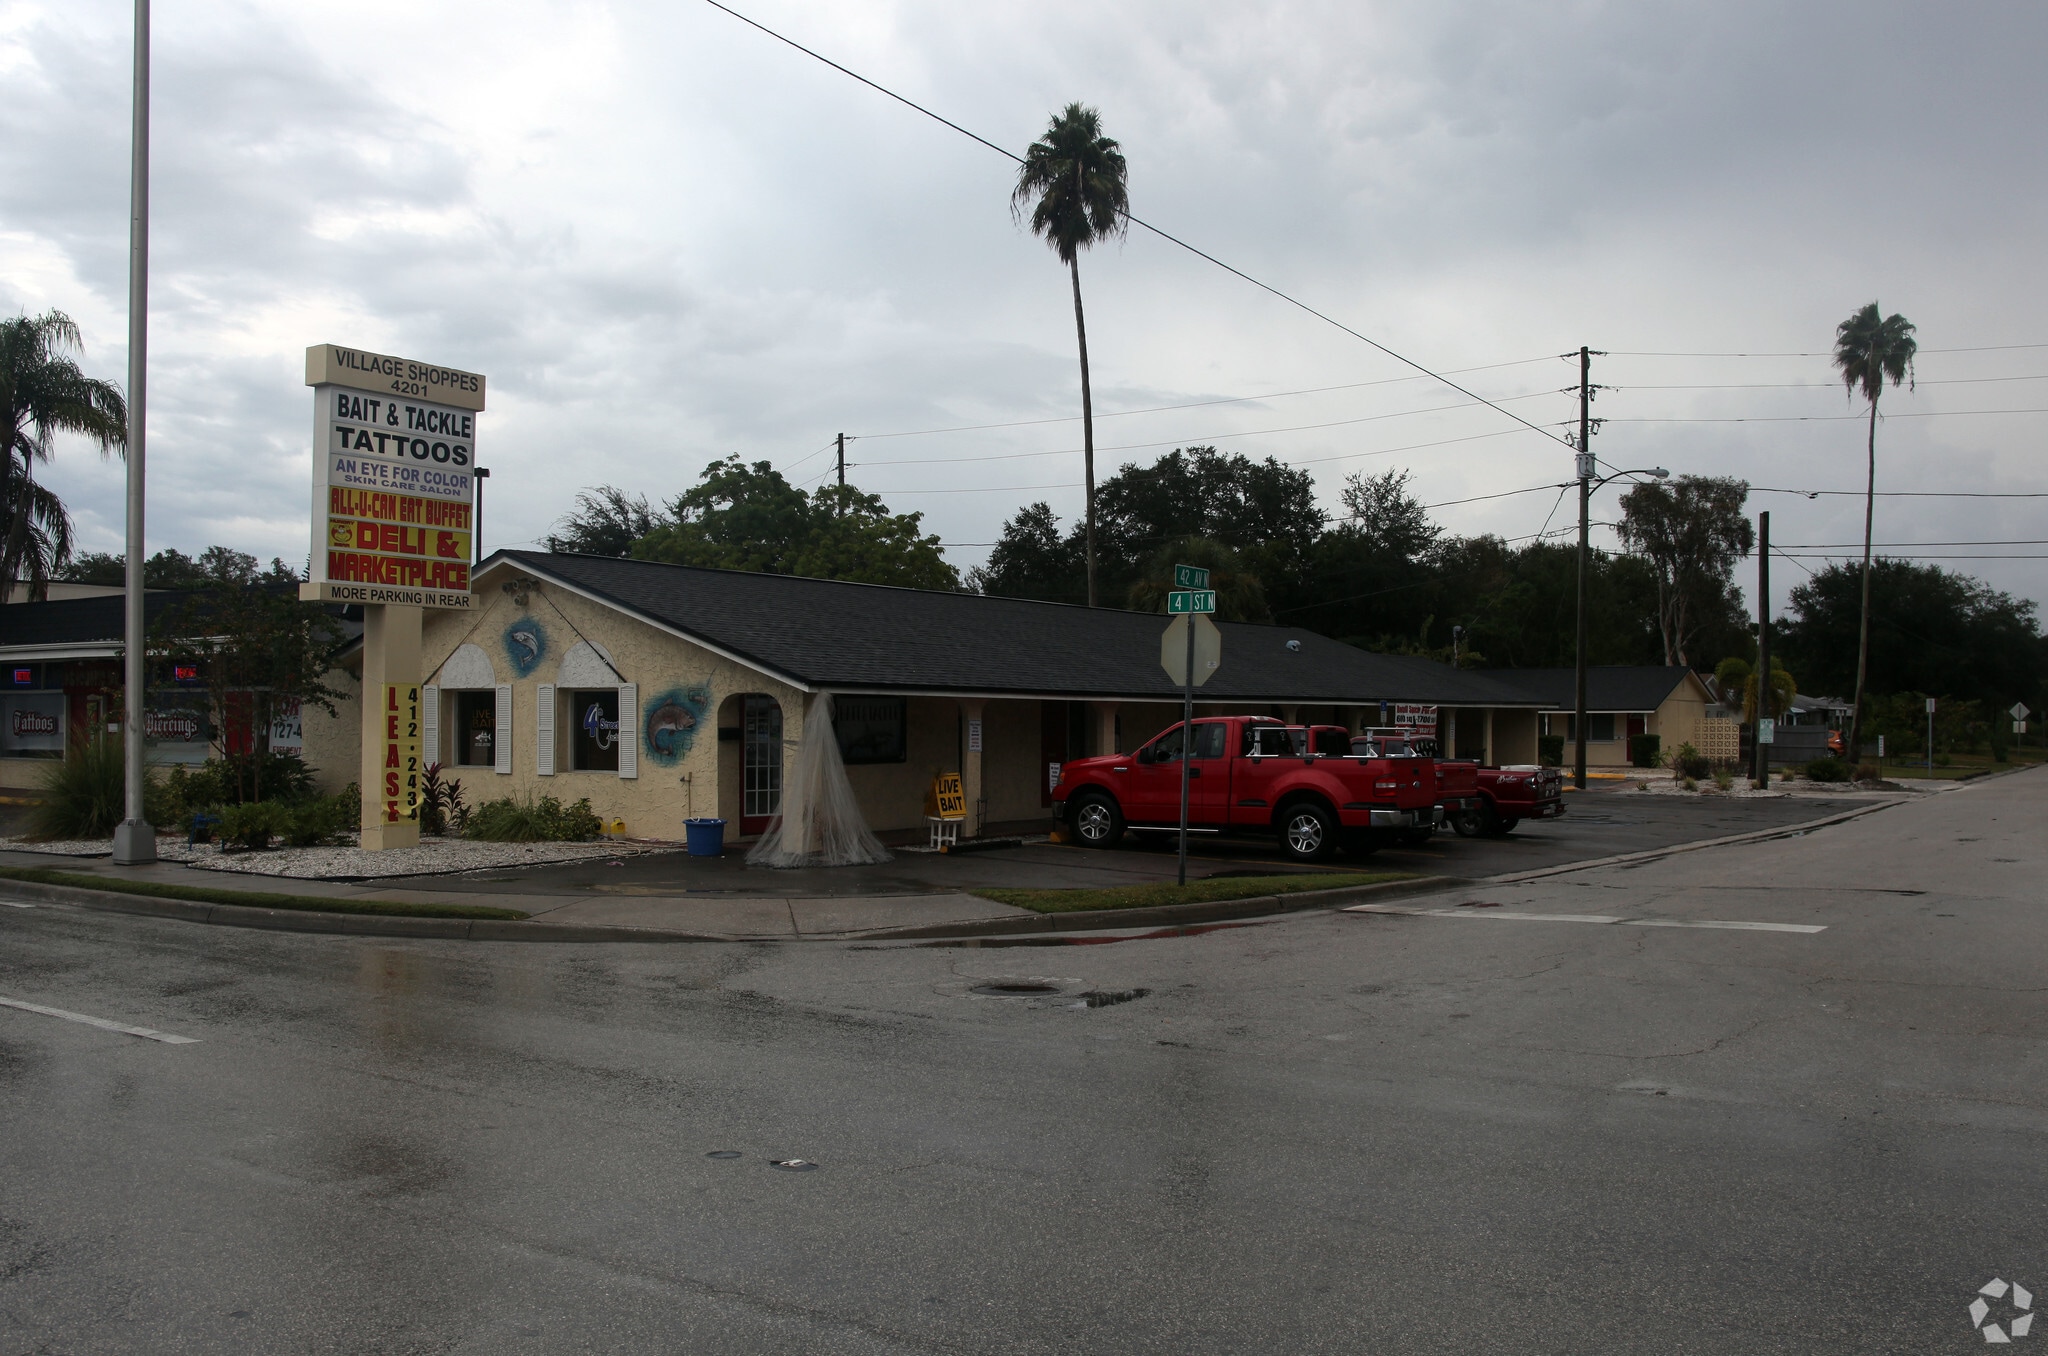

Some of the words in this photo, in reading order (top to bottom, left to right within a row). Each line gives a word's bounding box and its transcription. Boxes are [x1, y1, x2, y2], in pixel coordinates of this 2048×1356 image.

[335, 349, 403, 378] VILLAGE
[408, 364, 479, 393] SHOPPES
[391, 380, 428, 397] 4201
[338, 393, 380, 423] BAIT
[386, 403, 399, 427] &
[405, 405, 471, 439] TACKLE
[336, 425, 468, 466] TATTOOS
[336, 458, 356, 474] AN
[361, 462, 388, 479] EYE
[393, 466, 420, 483] FOR
[424, 470, 468, 489] COLOR
[344, 474, 377, 486] SKIN
[381, 478, 416, 491] CARE
[419, 484, 461, 497] SALON
[400, 496, 423, 523] EAT
[426, 499, 470, 529] BUFFET
[357, 521, 426, 555] DELI
[437, 531, 461, 559] &
[328, 551, 470, 591] MARKETPLACE
[1180, 568, 1190, 585] 42
[1193, 571, 1203, 587] AV
[1203, 572, 1209, 588] N
[331, 586, 367, 600] MORE
[370, 589, 422, 604] PARKING
[425, 593, 436, 606] IN
[440, 594, 470, 607] REAR
[1174, 594, 1182, 610] 4
[1194, 594, 1205, 610] ST
[1208, 593, 1214, 610] N
[13, 710, 55, 735] Tattoos
[145, 712, 198, 740] Piercings
[939, 779, 959, 794] LIVE
[940, 796, 962, 811] BAIT
